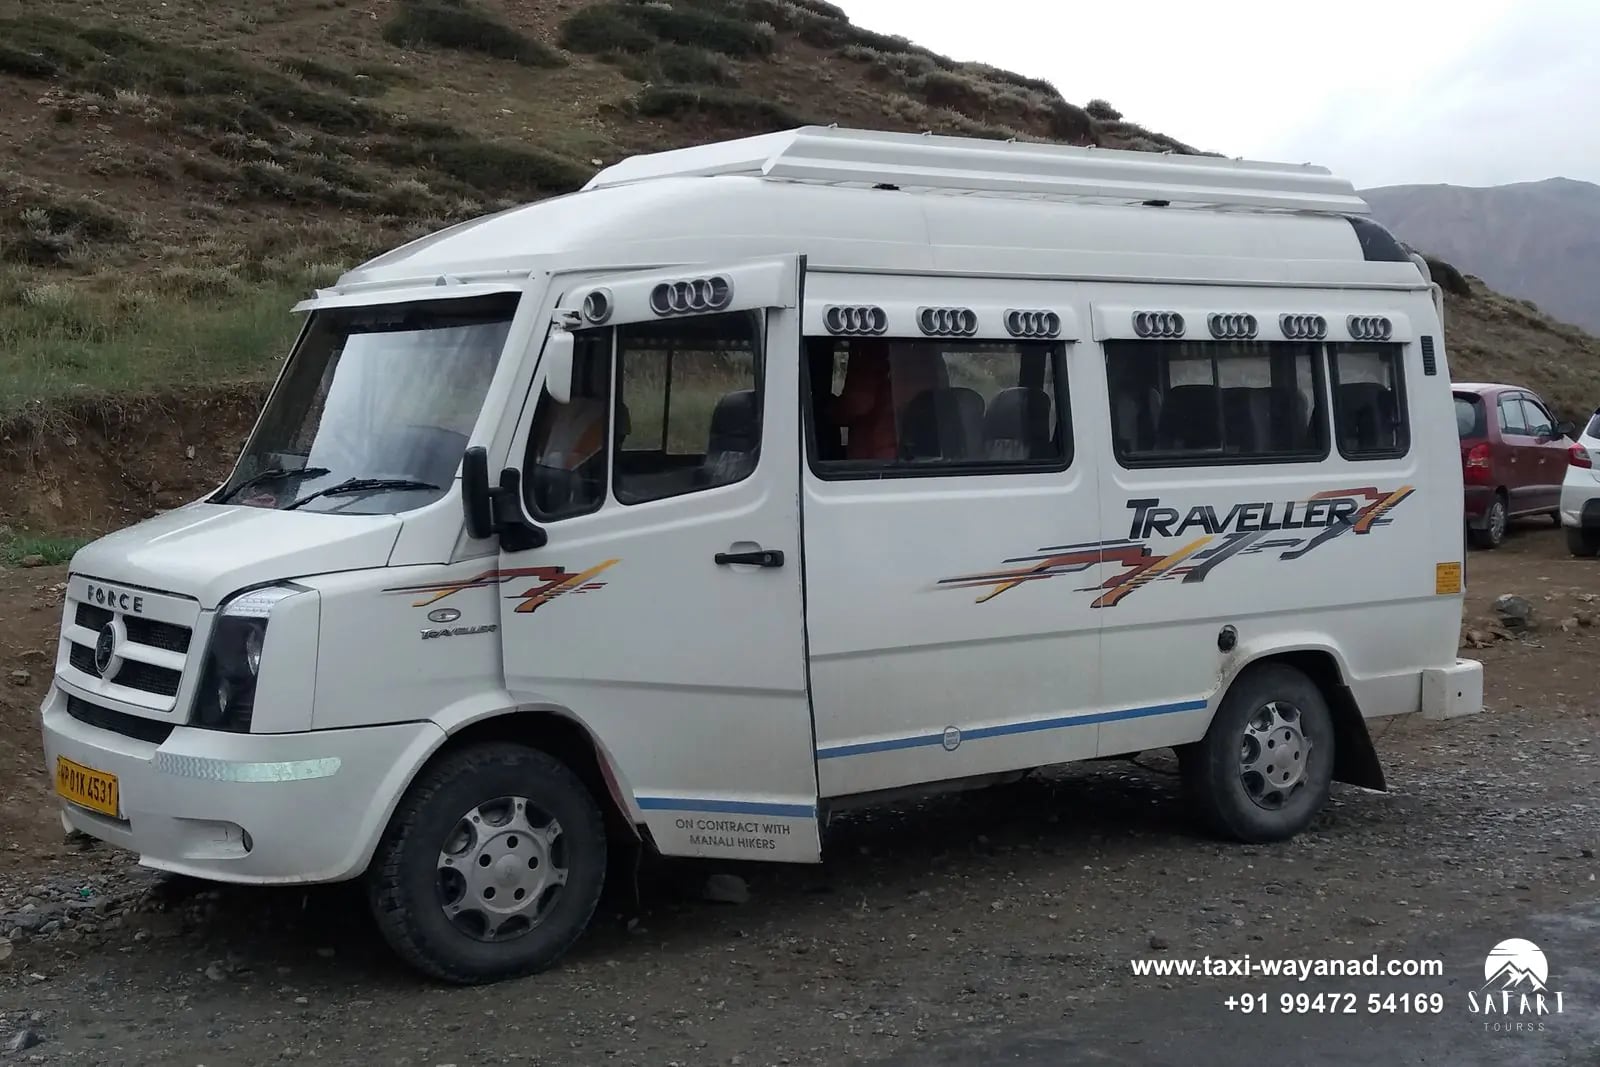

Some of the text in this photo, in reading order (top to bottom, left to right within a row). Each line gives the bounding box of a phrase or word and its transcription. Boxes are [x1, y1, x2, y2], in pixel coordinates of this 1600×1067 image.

[1126, 498, 1358, 540] TRAVELLER
[87, 584, 143, 613] FORCE
[87, 775, 113, 806] 4531
[675, 818, 790, 835] ON CONTRACT WITH
[690, 835, 775, 849] MANALI HIKERS
